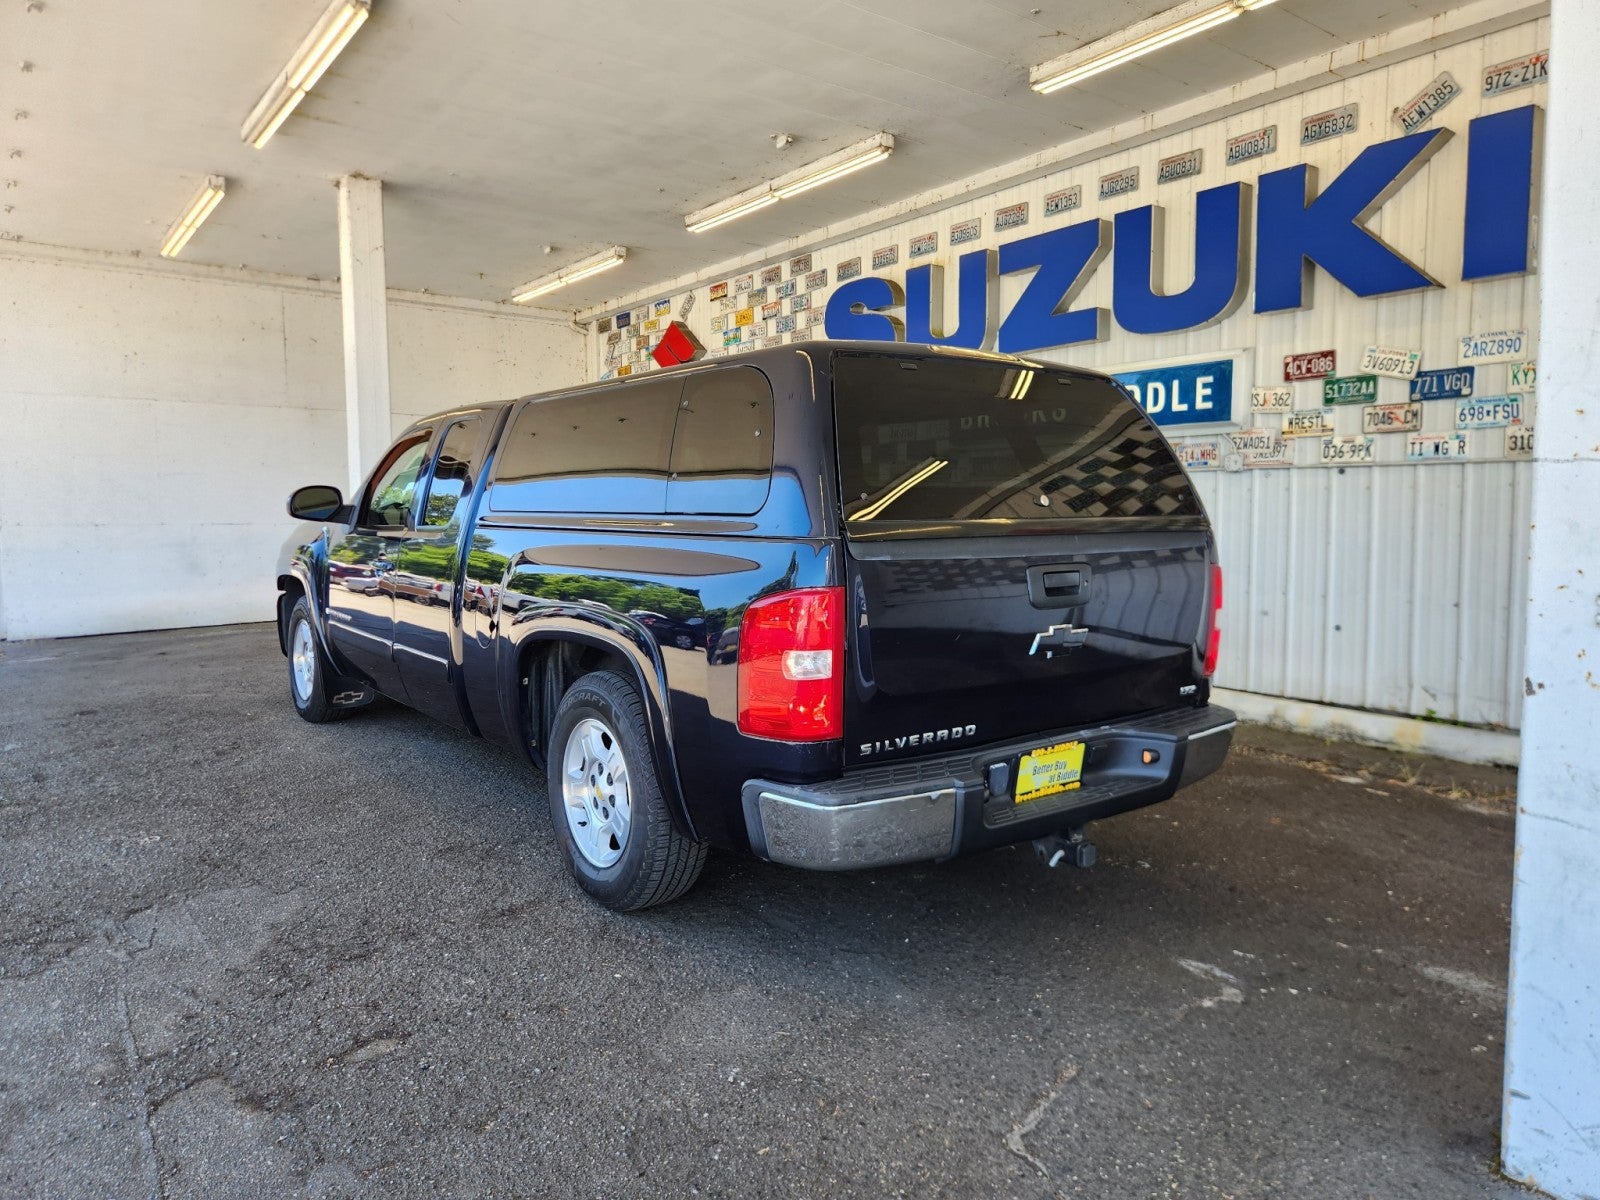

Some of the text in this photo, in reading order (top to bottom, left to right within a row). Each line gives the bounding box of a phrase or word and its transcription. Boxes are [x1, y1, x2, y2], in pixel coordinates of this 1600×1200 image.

[1485, 59, 1549, 92] 972-ZIK
[1401, 79, 1454, 131] AEW1385
[1303, 113, 1353, 141] AGY6832
[825, 104, 1536, 353] SUZUKI
[1463, 337, 1522, 358] 2ARZ890
[1325, 380, 1375, 399] 51732AA
[1412, 376, 1437, 394] 771
[1271, 392, 1291, 407] 362
[1287, 415, 1328, 430] WRESTL
[1404, 409, 1419, 425] CM
[860, 724, 977, 756] SILVERADO
[1032, 760, 1068, 776] Better Buy
